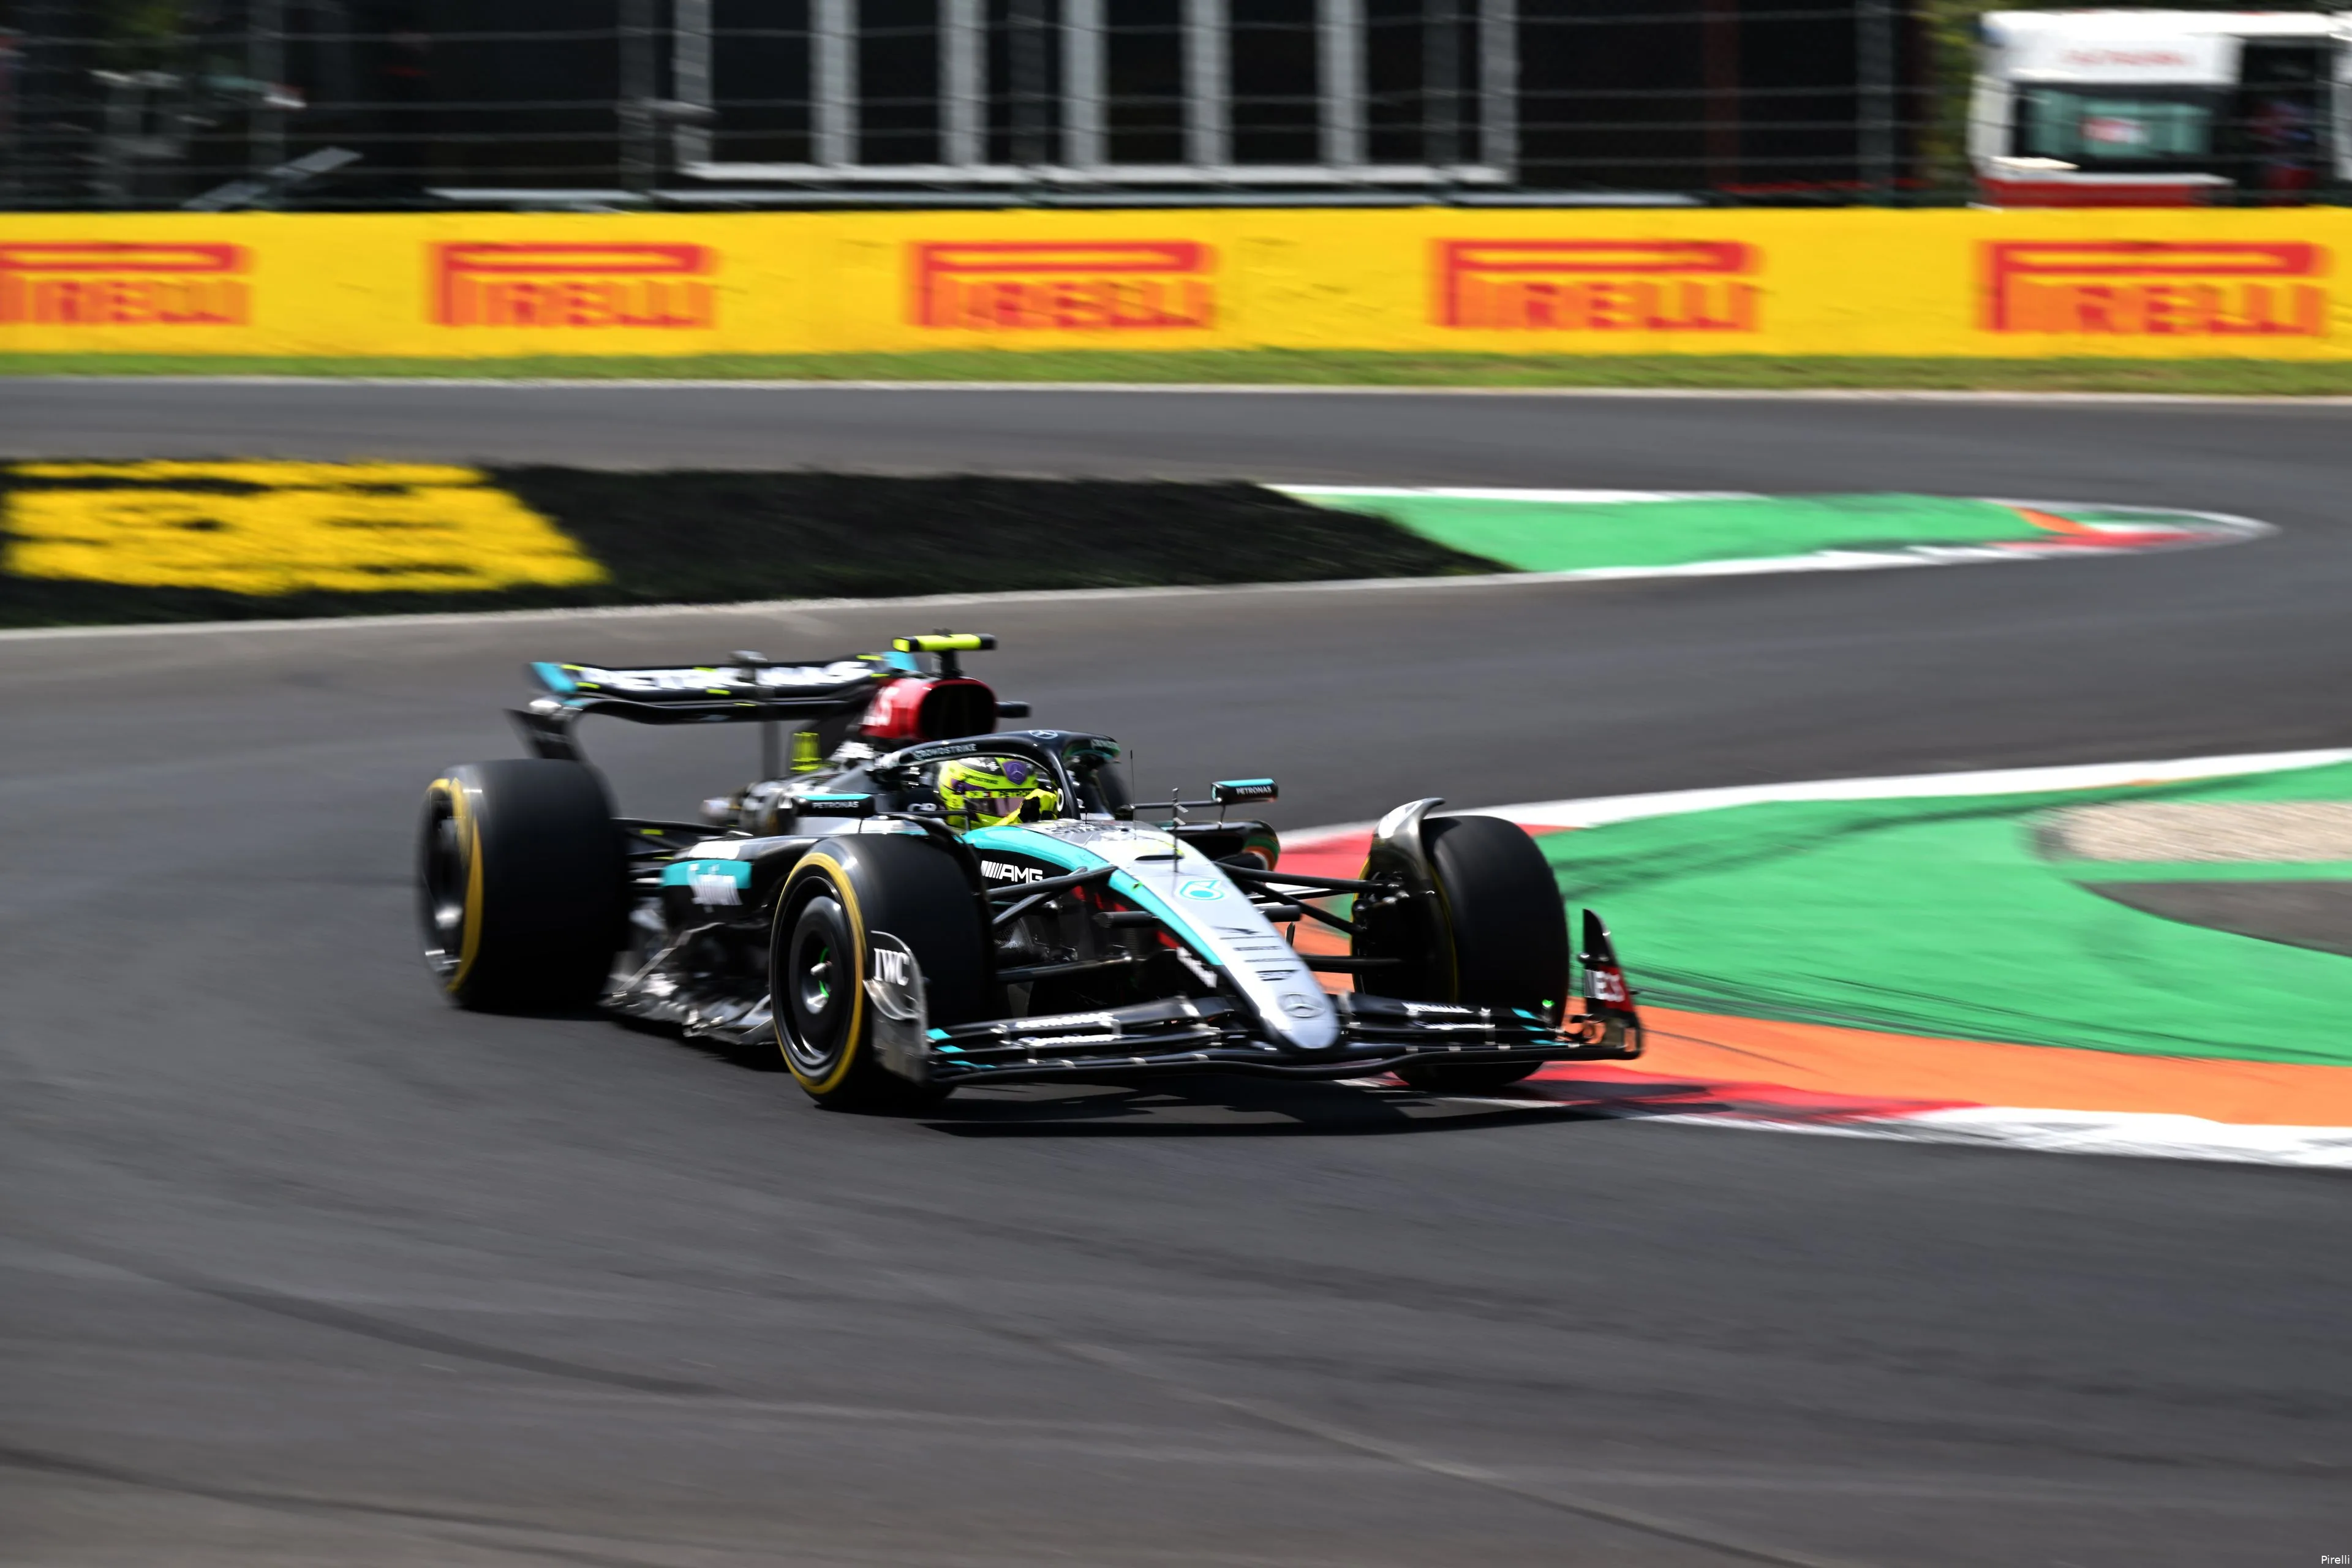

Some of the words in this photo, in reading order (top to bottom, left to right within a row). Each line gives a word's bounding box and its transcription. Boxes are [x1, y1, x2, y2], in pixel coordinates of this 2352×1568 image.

[425, 240, 719, 327] PIRELLI
[905, 239, 1215, 328] PIRELLI
[1428, 238, 1763, 331] PIRELLI
[1975, 240, 2331, 334] PIRELLI
[914, 743, 978, 759] CROWDSTRIKE
[1235, 786, 1272, 795] PETRONAS
[874, 948, 910, 986] IWC
